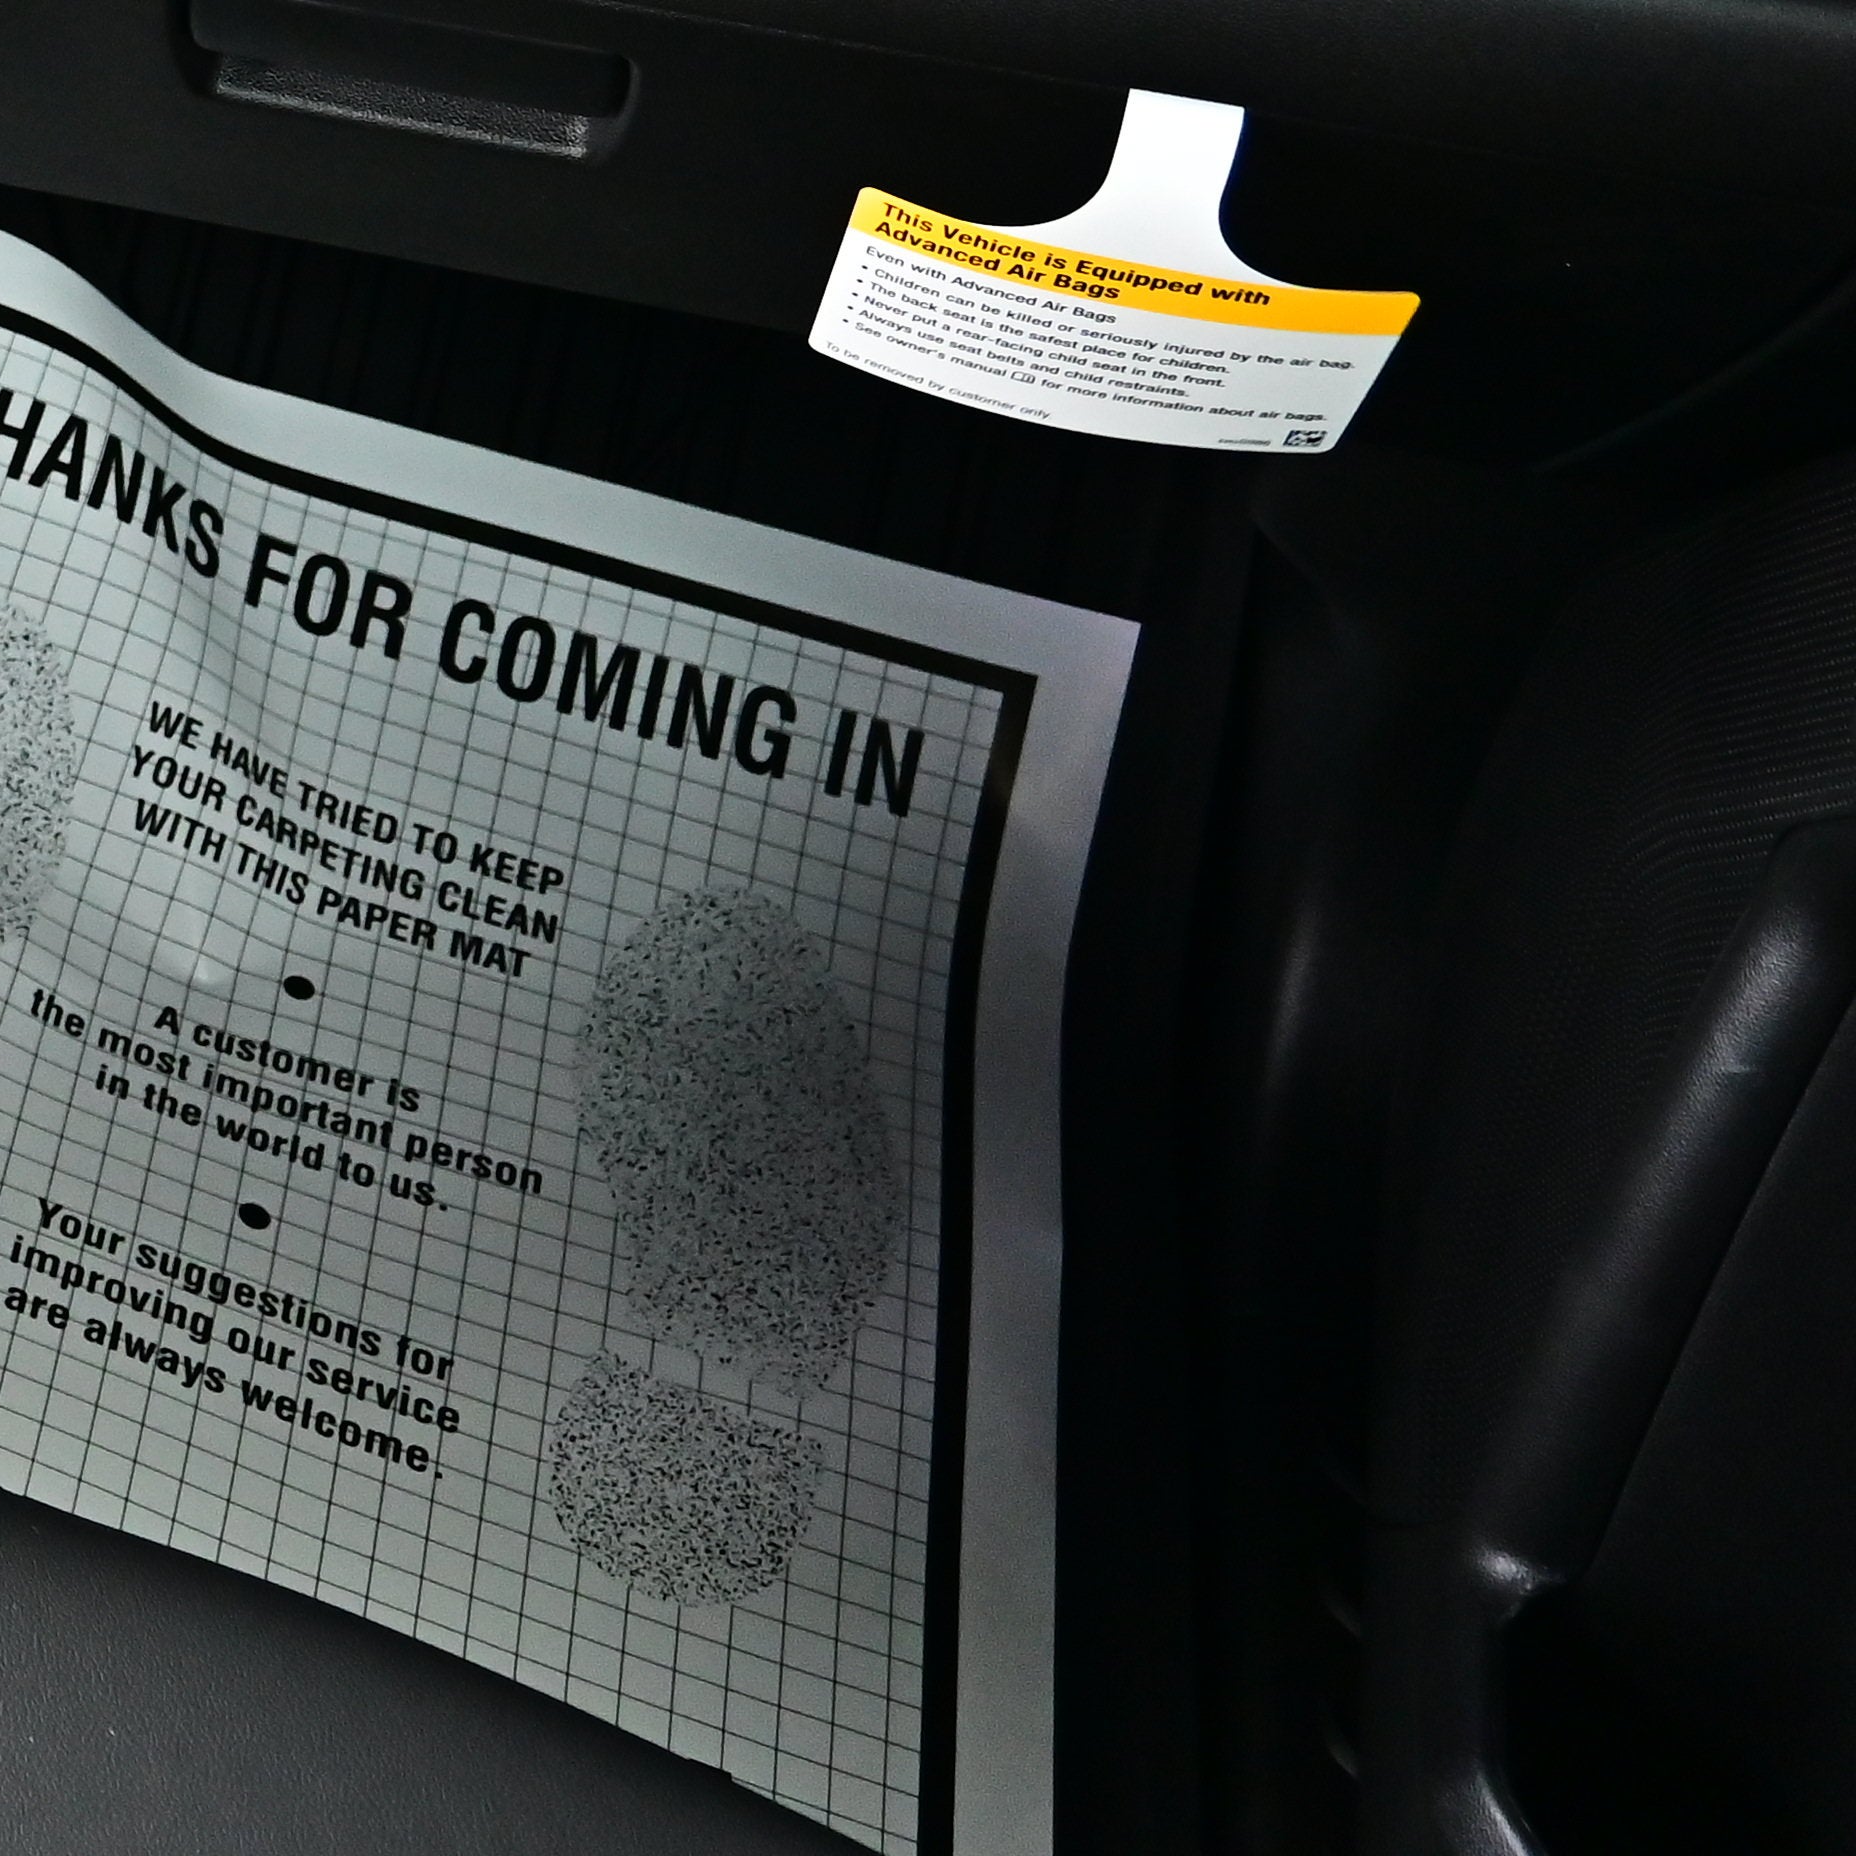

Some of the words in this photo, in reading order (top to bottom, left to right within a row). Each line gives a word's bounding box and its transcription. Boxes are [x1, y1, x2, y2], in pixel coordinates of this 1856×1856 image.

[866, 245, 905, 267] Even
[911, 263, 947, 281] with
[951, 276, 1038, 306] Advanced
[1041, 299, 1068, 313] Air
[1072, 307, 1117, 324] Bags
[875, 222, 1001, 271] Advanced
[1007, 264, 1047, 283] Air
[1053, 274, 1121, 299] Bags
[883, 202, 933, 232] This
[943, 225, 1036, 262] Vehicle
[1044, 253, 1067, 269] is
[1076, 259, 1203, 295] Equipped
[1211, 287, 1271, 306] with
[855, 321, 883, 338] See
[886, 335, 946, 360] owner's
[950, 356, 1007, 377] manual
[1041, 379, 1063, 390] for
[1067, 385, 1108, 399] more
[1112, 393, 1204, 413] information
[1208, 407, 1255, 418] about
[1259, 410, 1281, 419] air
[1284, 412, 1327, 422] bags.
[859, 309, 913, 335] Always
[917, 331, 944, 344] use
[949, 340, 982, 356] seat
[987, 350, 1025, 367] belts
[1029, 362, 1060, 376] and
[1064, 369, 1103, 384] child
[1108, 378, 1189, 397] restraints.
[864, 295, 909, 317] Never
[912, 313, 939, 329] put
[956, 327, 1044, 358] rear-facing
[1048, 351, 1088, 366] child
[1092, 360, 1127, 374] seat
[1131, 366, 1146, 377] in
[1152, 370, 1178, 382] the
[1183, 375, 1227, 388] front.
[870, 282, 896, 299] The
[901, 294, 939, 313] back
[942, 308, 976, 324] seat
[980, 317, 994, 329] is
[999, 324, 1024, 337] the
[1028, 332, 1078, 349] safest
[1081, 343, 1127, 359] place
[1131, 352, 1156, 364] for
[1159, 357, 1231, 374] children.
[874, 268, 940, 298] Children
[946, 294, 975, 308] can
[981, 303, 1001, 316] be
[1006, 310, 1053, 329] killed
[1057, 323, 1076, 333] or
[1081, 328, 1159, 351] seriously
[1164, 342, 1225, 360] injured
[1229, 351, 1252, 363] by
[1257, 354, 1284, 365] the
[1289, 357, 1314, 367] air
[1319, 359, 1356, 370] bag.
[826, 340, 840, 354] To
[843, 349, 860, 361] be
[864, 357, 924, 384] removed
[928, 380, 945, 392] by
[948, 386, 1017, 411] customer
[1020, 405, 1051, 420] only
[245, 531, 413, 660] FOR
[439, 598, 797, 779] COMING
[824, 709, 925, 818] IN
[131, 745, 227, 811] YOUR
[236, 794, 425, 902] CARPETING
[438, 880, 558, 944] CLEAN
[149, 700, 204, 750] WE
[210, 731, 289, 799] HAVE
[298, 780, 399, 846] TRIED
[412, 822, 459, 865] TO
[470, 842, 565, 897] KEEP
[134, 798, 227, 864] WITH
[236, 842, 310, 905] THIS
[316, 886, 438, 952] PAPER
[449, 930, 531, 978] MAT
[30, 988, 86, 1038] the
[97, 1025, 191, 1082] most
[202, 1063, 393, 1149] important
[405, 1131, 543, 1195] person
[153, 1005, 180, 1036] A
[192, 1021, 375, 1097] customer
[386, 1078, 421, 1113] is
[94, 1064, 131, 1100] in
[143, 1082, 202, 1128] the
[216, 1112, 325, 1172] world
[338, 1151, 376, 1188] to
[390, 1172, 449, 1212] us.
[9, 1234, 215, 1346] improving
[227, 1325, 295, 1371] our
[305, 1357, 461, 1435] service
[38, 1197, 126, 1255] Your
[135, 1241, 382, 1357] suggestions
[395, 1334, 455, 1382] for
[3, 1285, 71, 1330] are
[83, 1316, 227, 1394] always
[241, 1379, 444, 1480] welcome.
